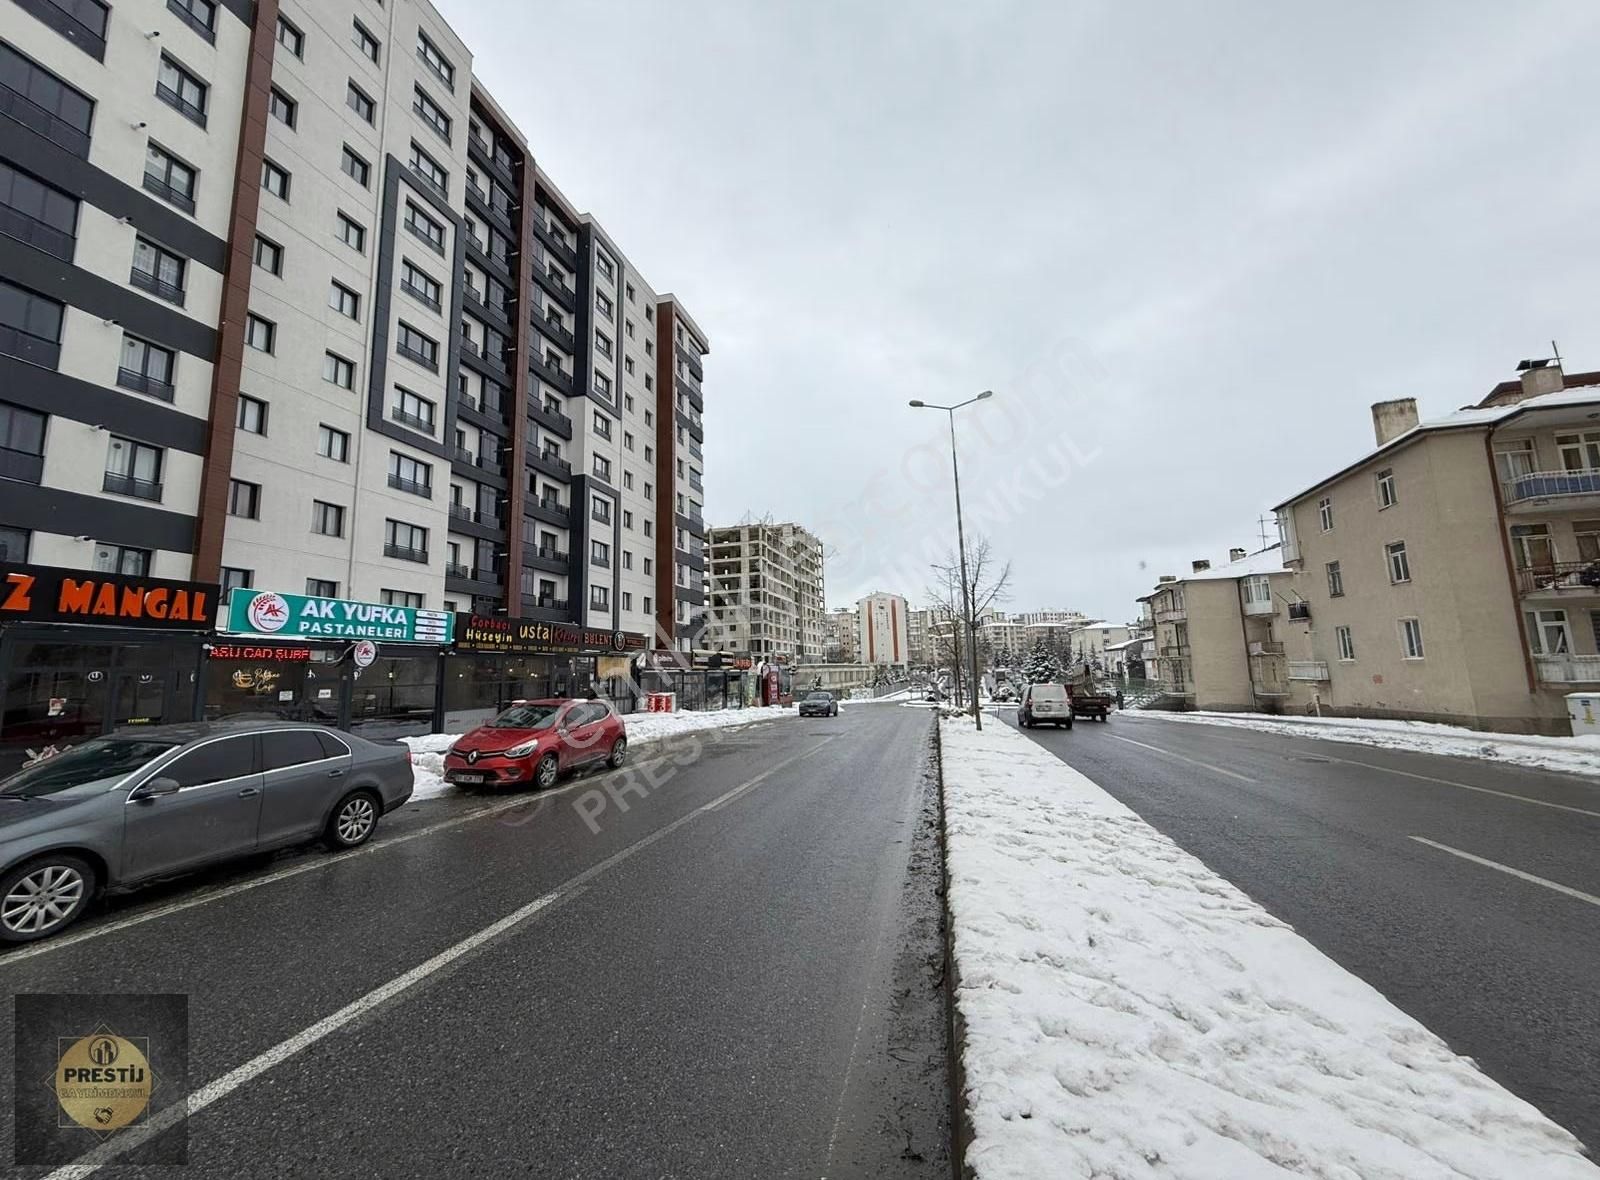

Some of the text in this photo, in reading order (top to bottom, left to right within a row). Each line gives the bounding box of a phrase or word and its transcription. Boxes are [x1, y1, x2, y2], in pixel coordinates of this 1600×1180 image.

[58, 578, 208, 621] MANGAL
[301, 600, 408, 624] AK YUFKA
[299, 621, 408, 639] PASTANELERİ
[466, 628, 513, 643] Hüseyin
